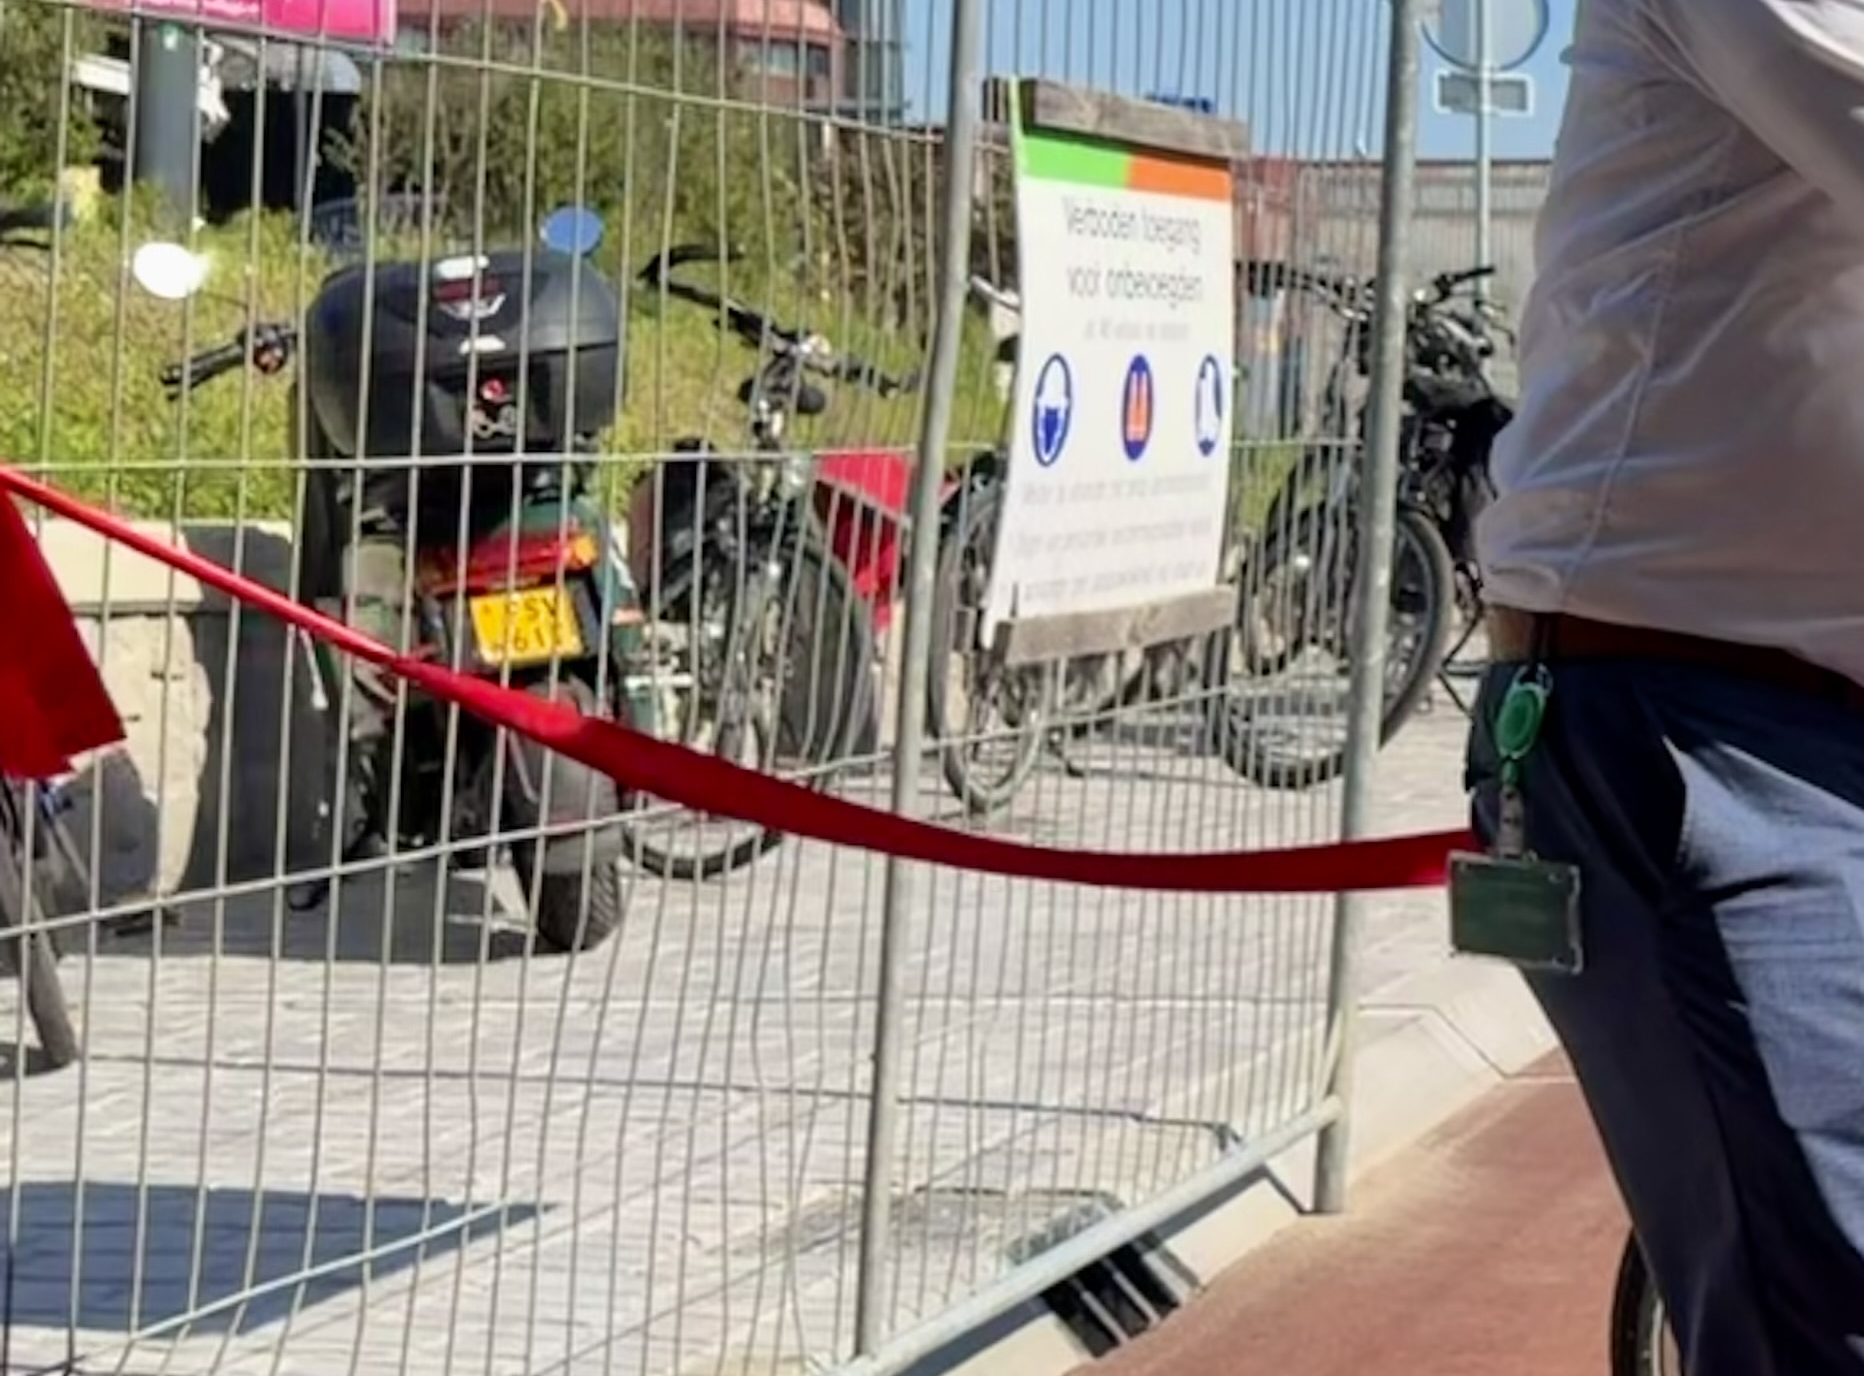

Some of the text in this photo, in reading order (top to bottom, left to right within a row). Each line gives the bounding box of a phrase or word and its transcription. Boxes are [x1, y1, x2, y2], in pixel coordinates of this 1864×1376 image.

[1061, 196, 1202, 255] Verboden toegang
[1067, 265, 1102, 299] voor
